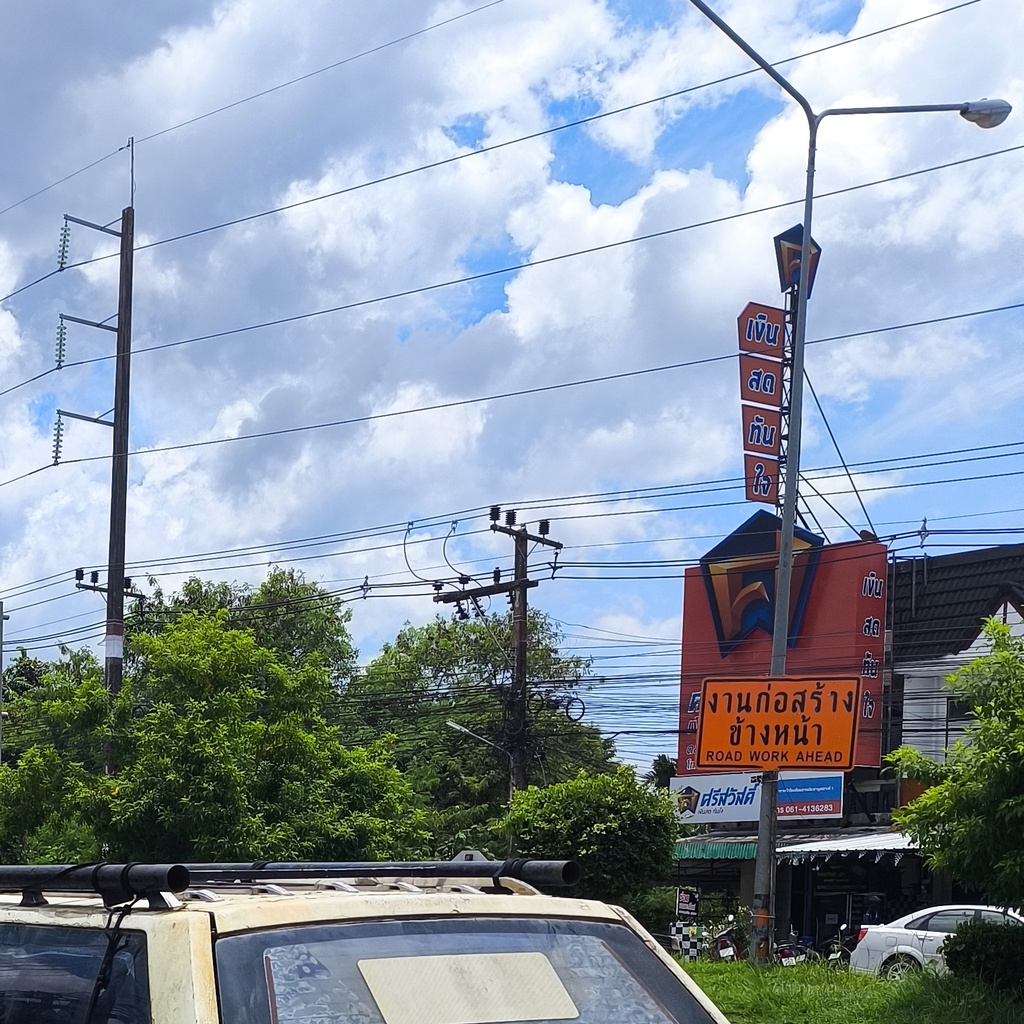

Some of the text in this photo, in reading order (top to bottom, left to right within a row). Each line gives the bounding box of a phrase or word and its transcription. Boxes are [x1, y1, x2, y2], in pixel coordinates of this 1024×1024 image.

[746, 313, 780, 346] เงิน
[748, 368, 776, 395] สด
[748, 414, 776, 447] ทัน
[753, 462, 772, 496] ใจ
[708, 682, 853, 713] งานก่อสร้าง
[730, 716, 822, 746] ข้างหน้า
[706, 750, 843, 762] ROAD WORK AHEAD
